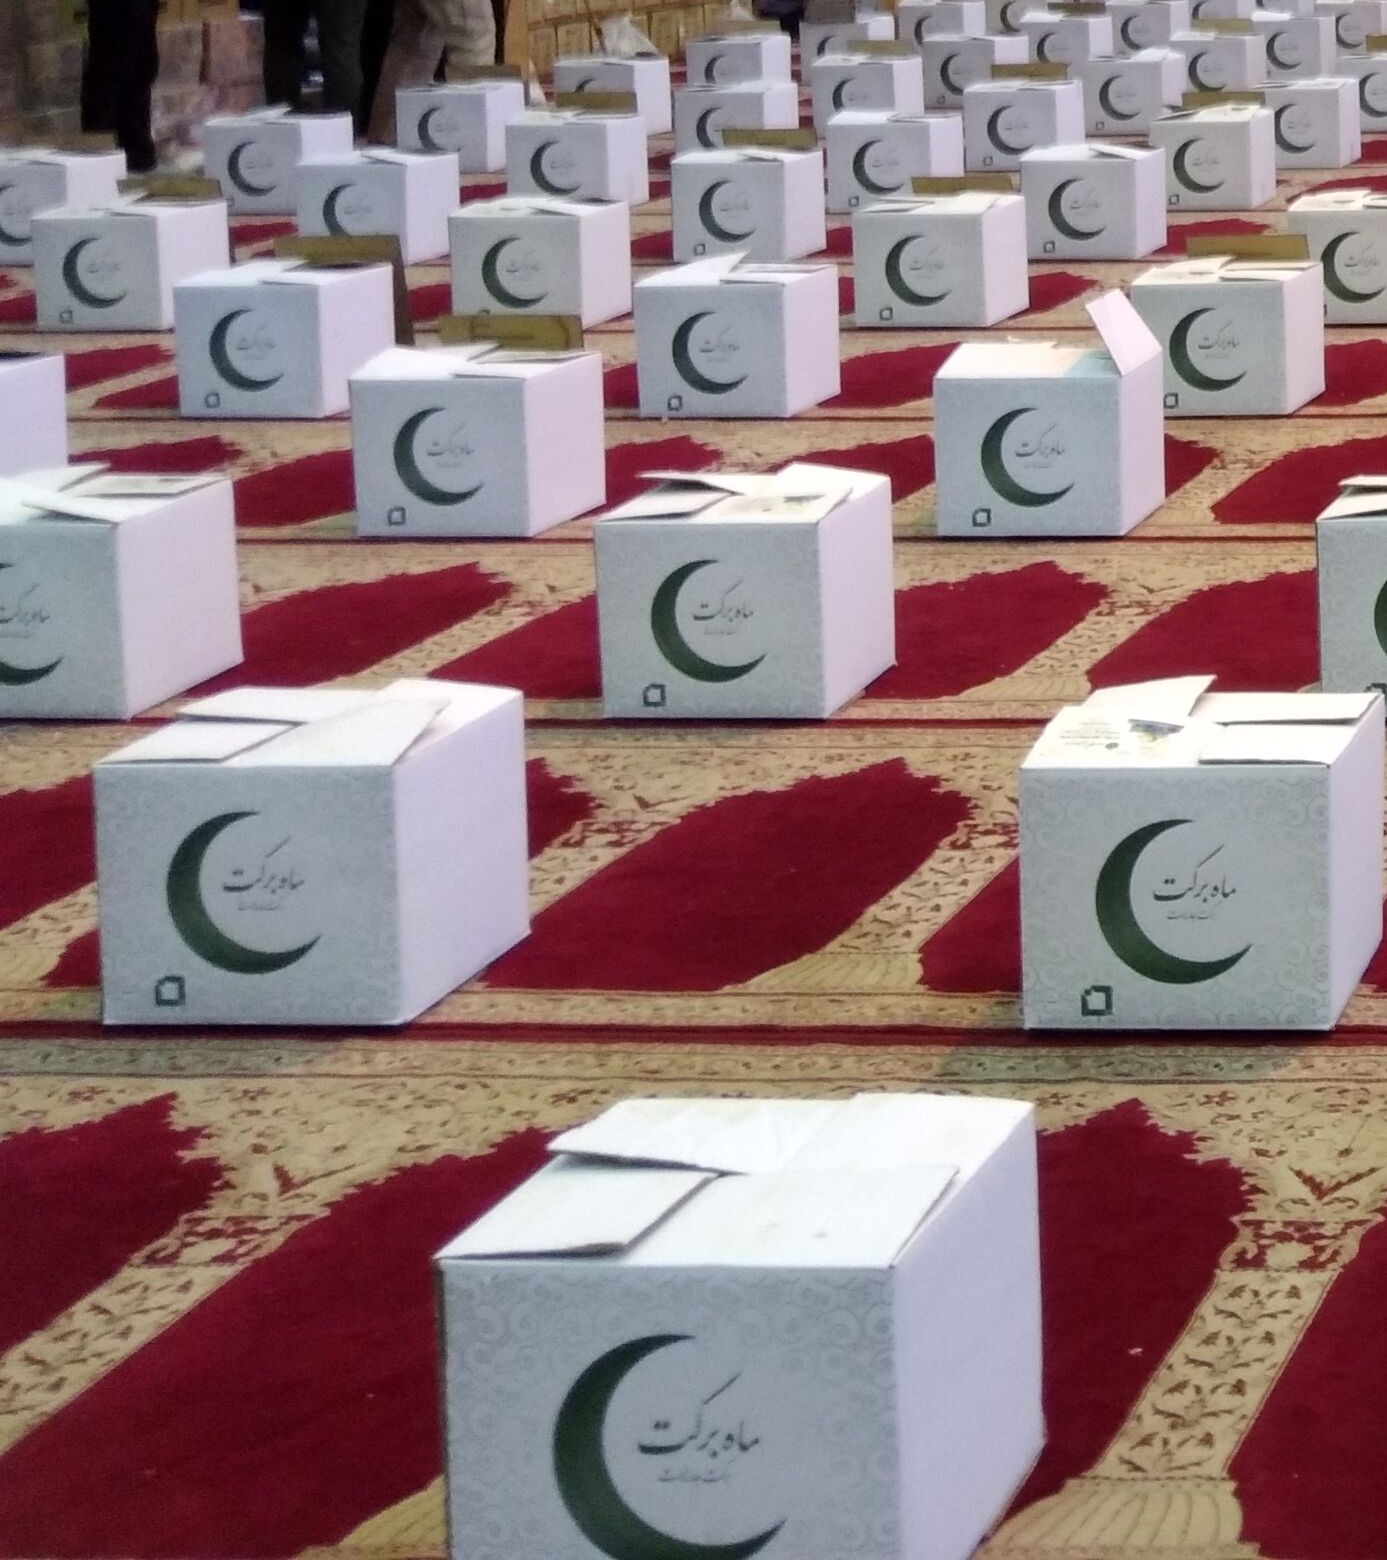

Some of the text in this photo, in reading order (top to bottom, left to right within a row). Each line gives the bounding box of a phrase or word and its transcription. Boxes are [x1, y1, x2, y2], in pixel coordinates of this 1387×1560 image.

[1153, 844, 1236, 904] ماه برکت
[637, 1372, 760, 1459] ماه برکت
